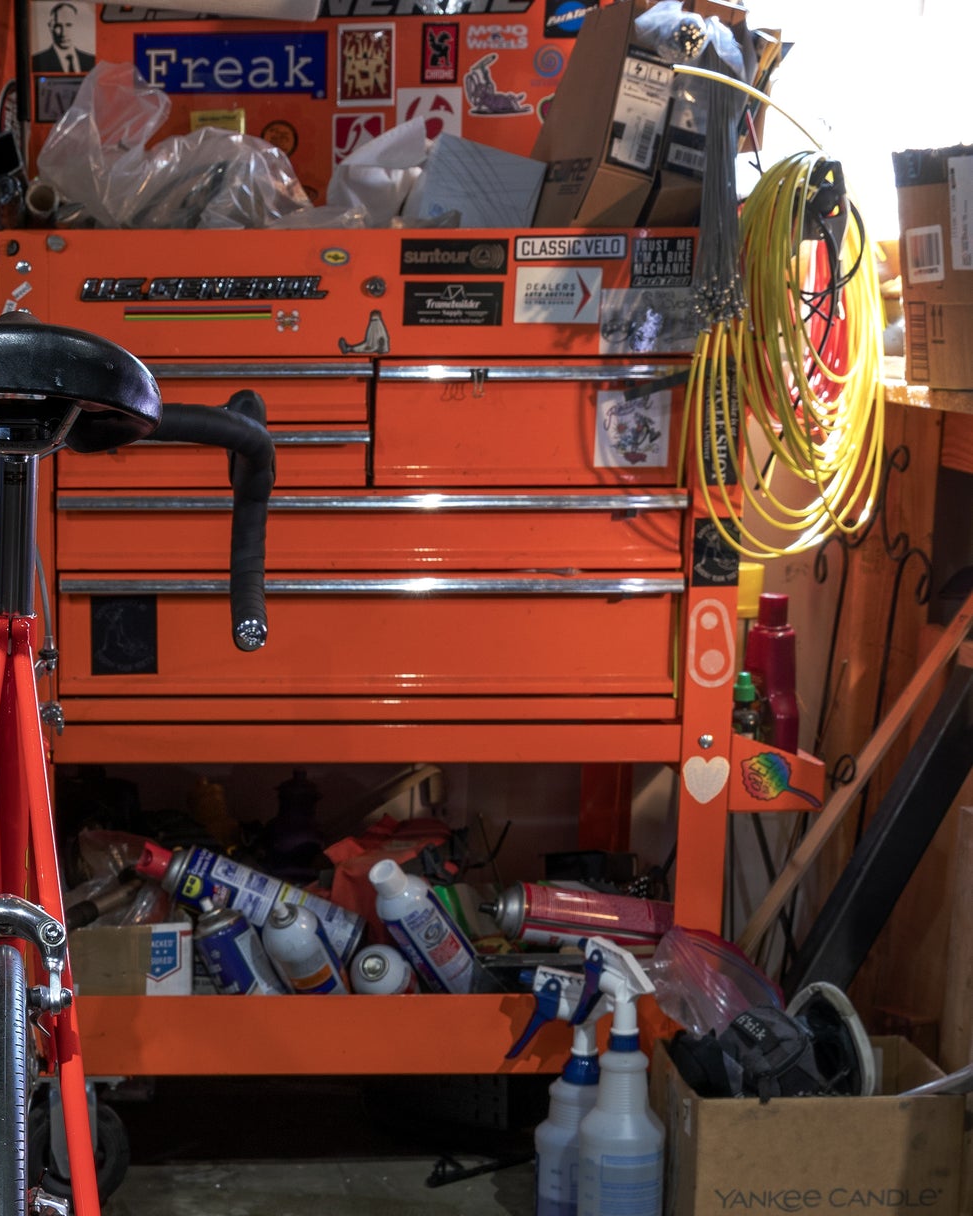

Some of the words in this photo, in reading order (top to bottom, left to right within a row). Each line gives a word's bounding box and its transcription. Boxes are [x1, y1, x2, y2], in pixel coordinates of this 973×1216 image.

[468, 24, 529, 37] MOJO
[145, 45, 314, 89] Freak
[521, 240, 582, 256] CLASSIC
[584, 238, 621, 255] VELO
[635, 239, 669, 251] TRUST
[677, 239, 692, 250] ME
[404, 248, 469, 264] suntour
[634, 251, 652, 262] I'M
[655, 251, 663, 262] A
[666, 250, 692, 262] BIKE
[633, 263, 691, 275] MECHANIC
[525, 283, 576, 291] DEALERS
